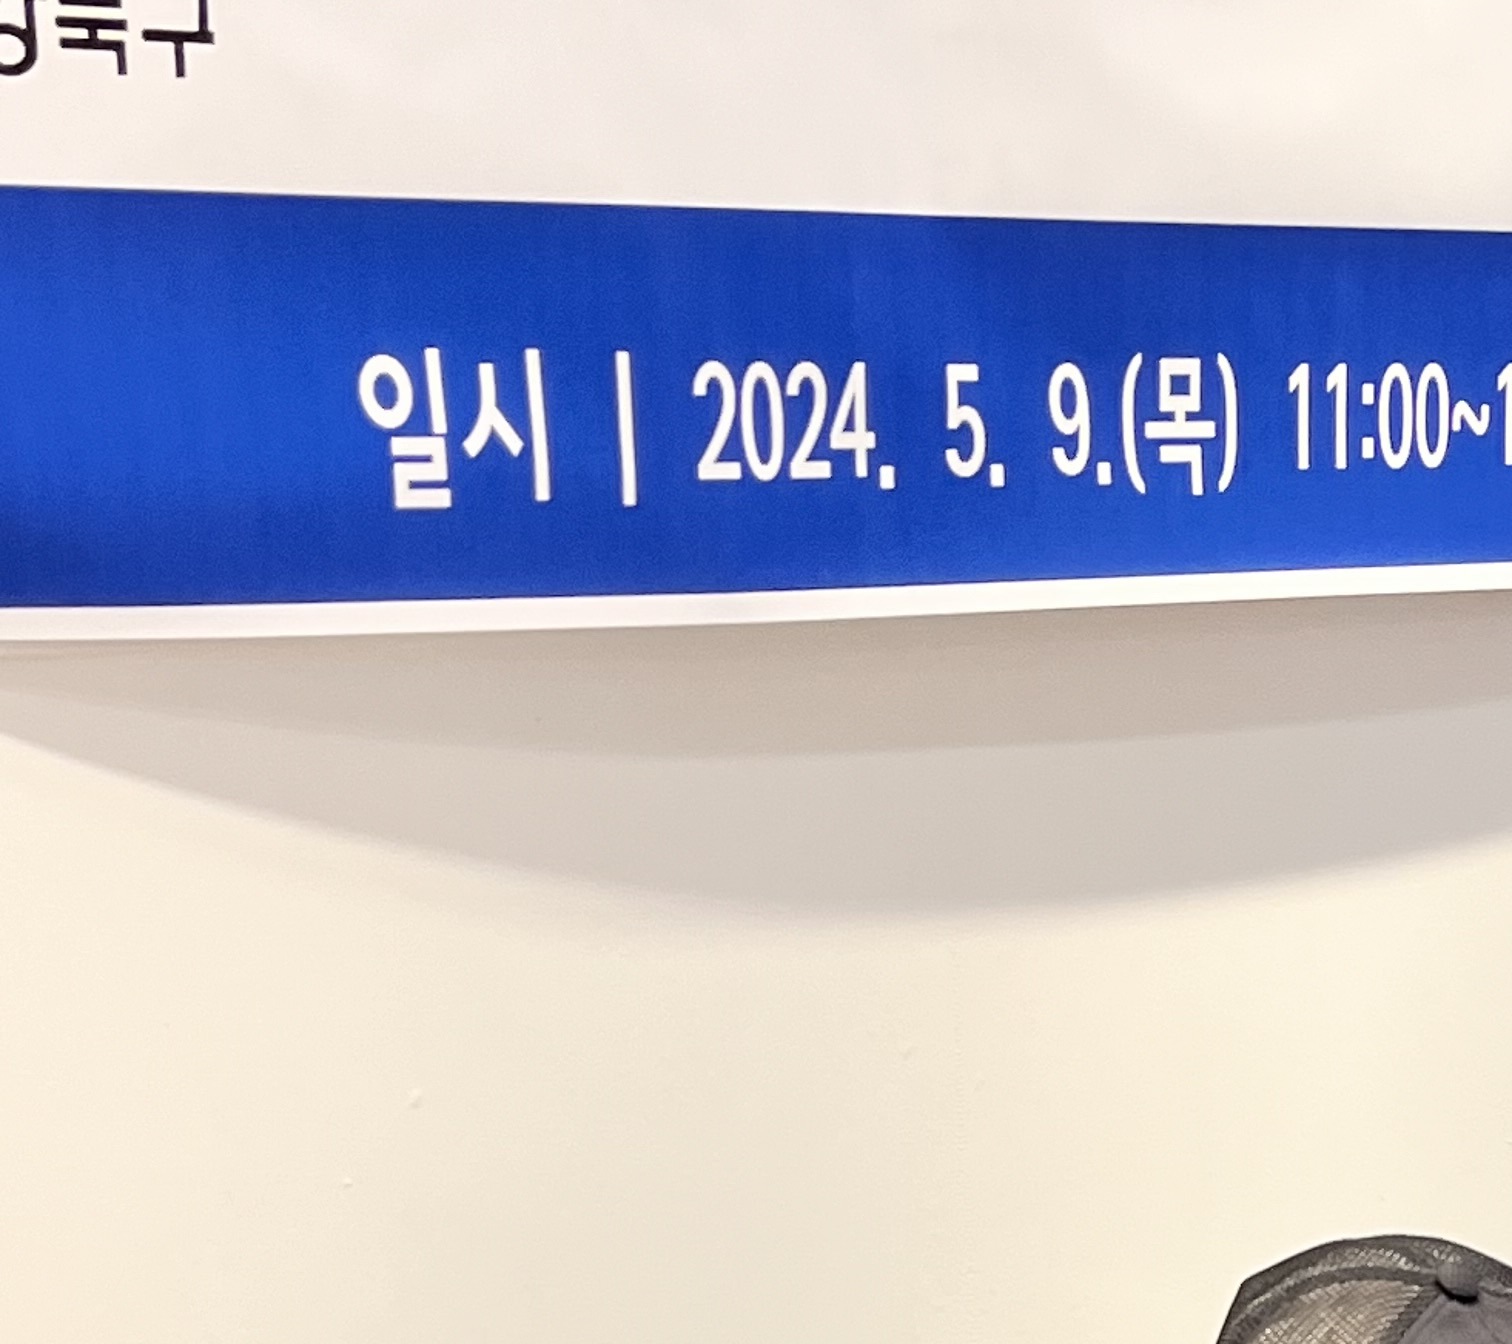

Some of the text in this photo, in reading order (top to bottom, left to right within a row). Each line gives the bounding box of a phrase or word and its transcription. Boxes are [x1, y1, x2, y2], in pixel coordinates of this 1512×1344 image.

[357, 346, 552, 511] 일시
[691, 359, 897, 491] 2024.
[944, 362, 1006, 489] 5.
[1047, 351, 1239, 497] 9.(목)
